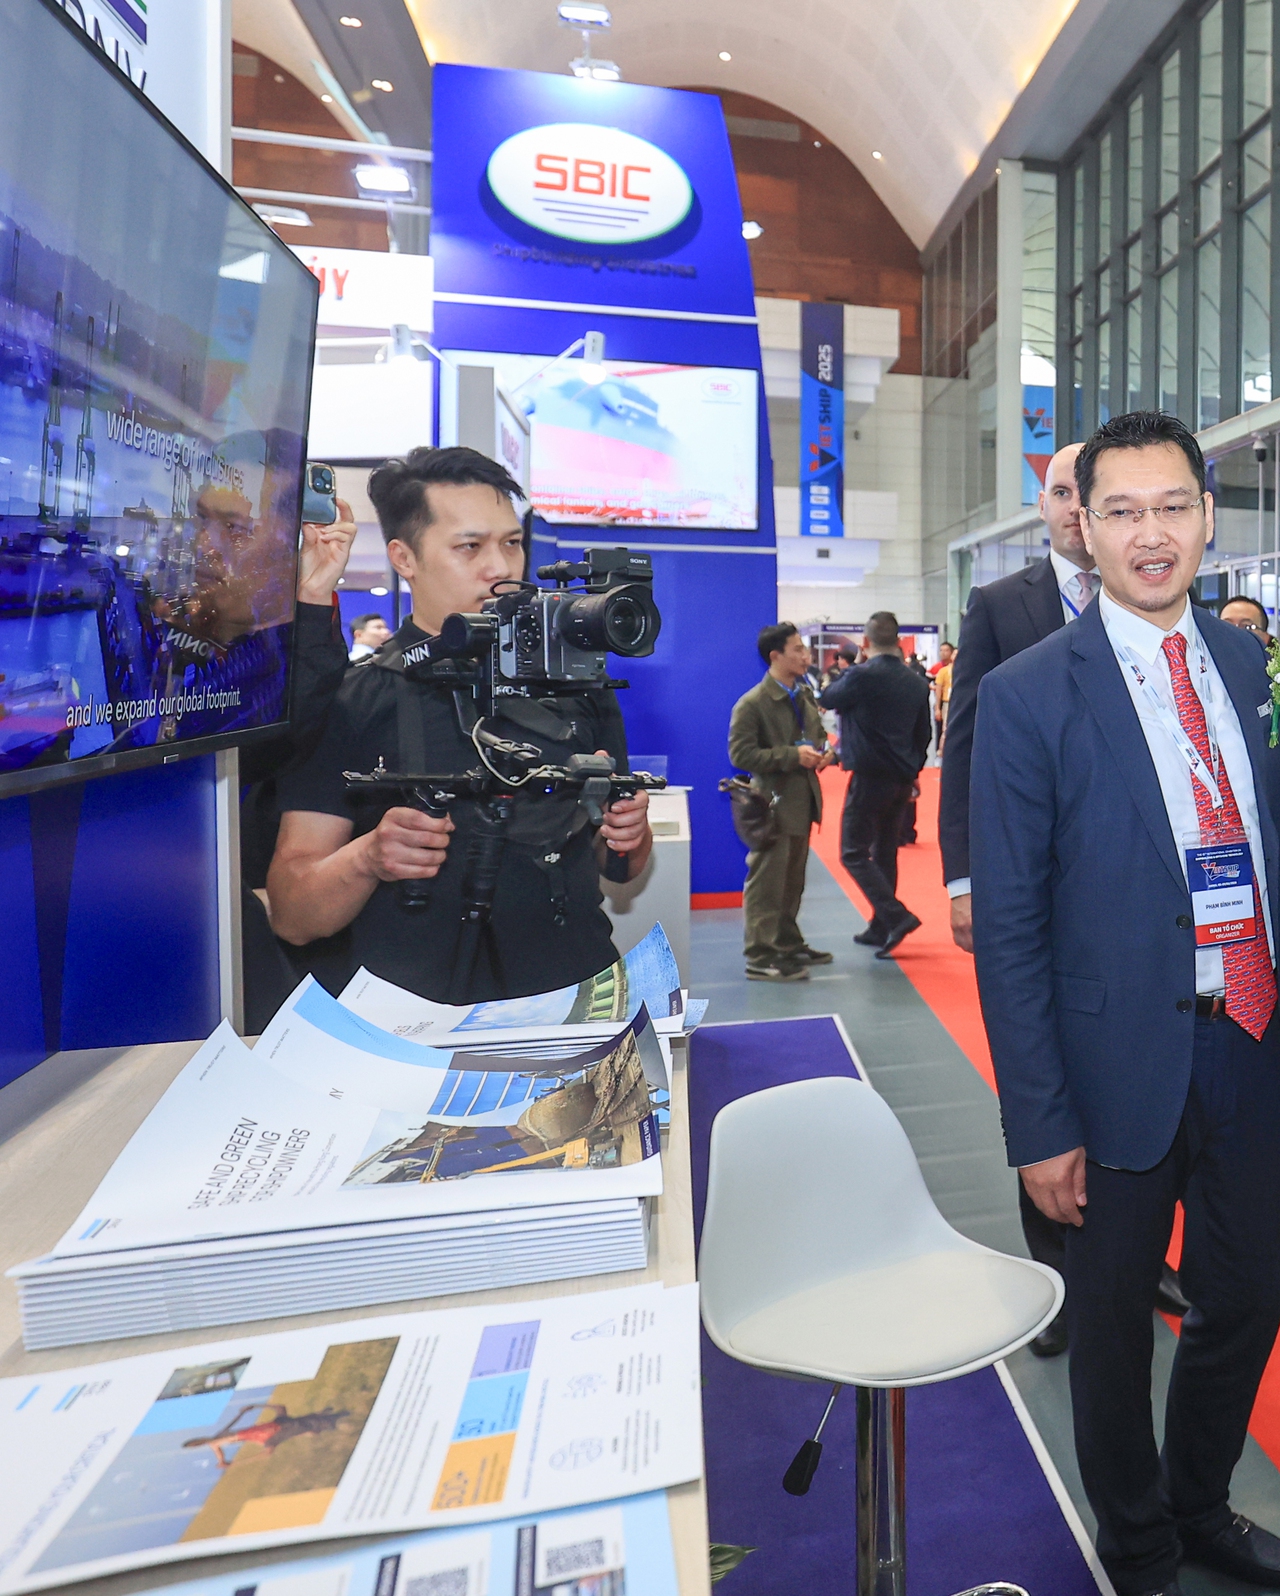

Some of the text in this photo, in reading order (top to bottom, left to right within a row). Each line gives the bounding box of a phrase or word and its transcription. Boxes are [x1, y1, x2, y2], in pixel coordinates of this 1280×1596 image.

[534, 154, 650, 202] SBIC
[818, 344, 833, 382] 2025
[107, 408, 142, 449] wide
[144, 426, 180, 471] range
[182, 438, 197, 467] of
[629, 557, 648, 565] SONY
[66, 685, 242, 727] and we expand our global footprint.
[1216, 931, 1240, 939] ORGANIZER
[187, 1117, 258, 1210] SAFE AND GREEN
[232, 1130, 281, 1197] RECYCLING
[260, 1128, 311, 1193] SHIPOWNERS
